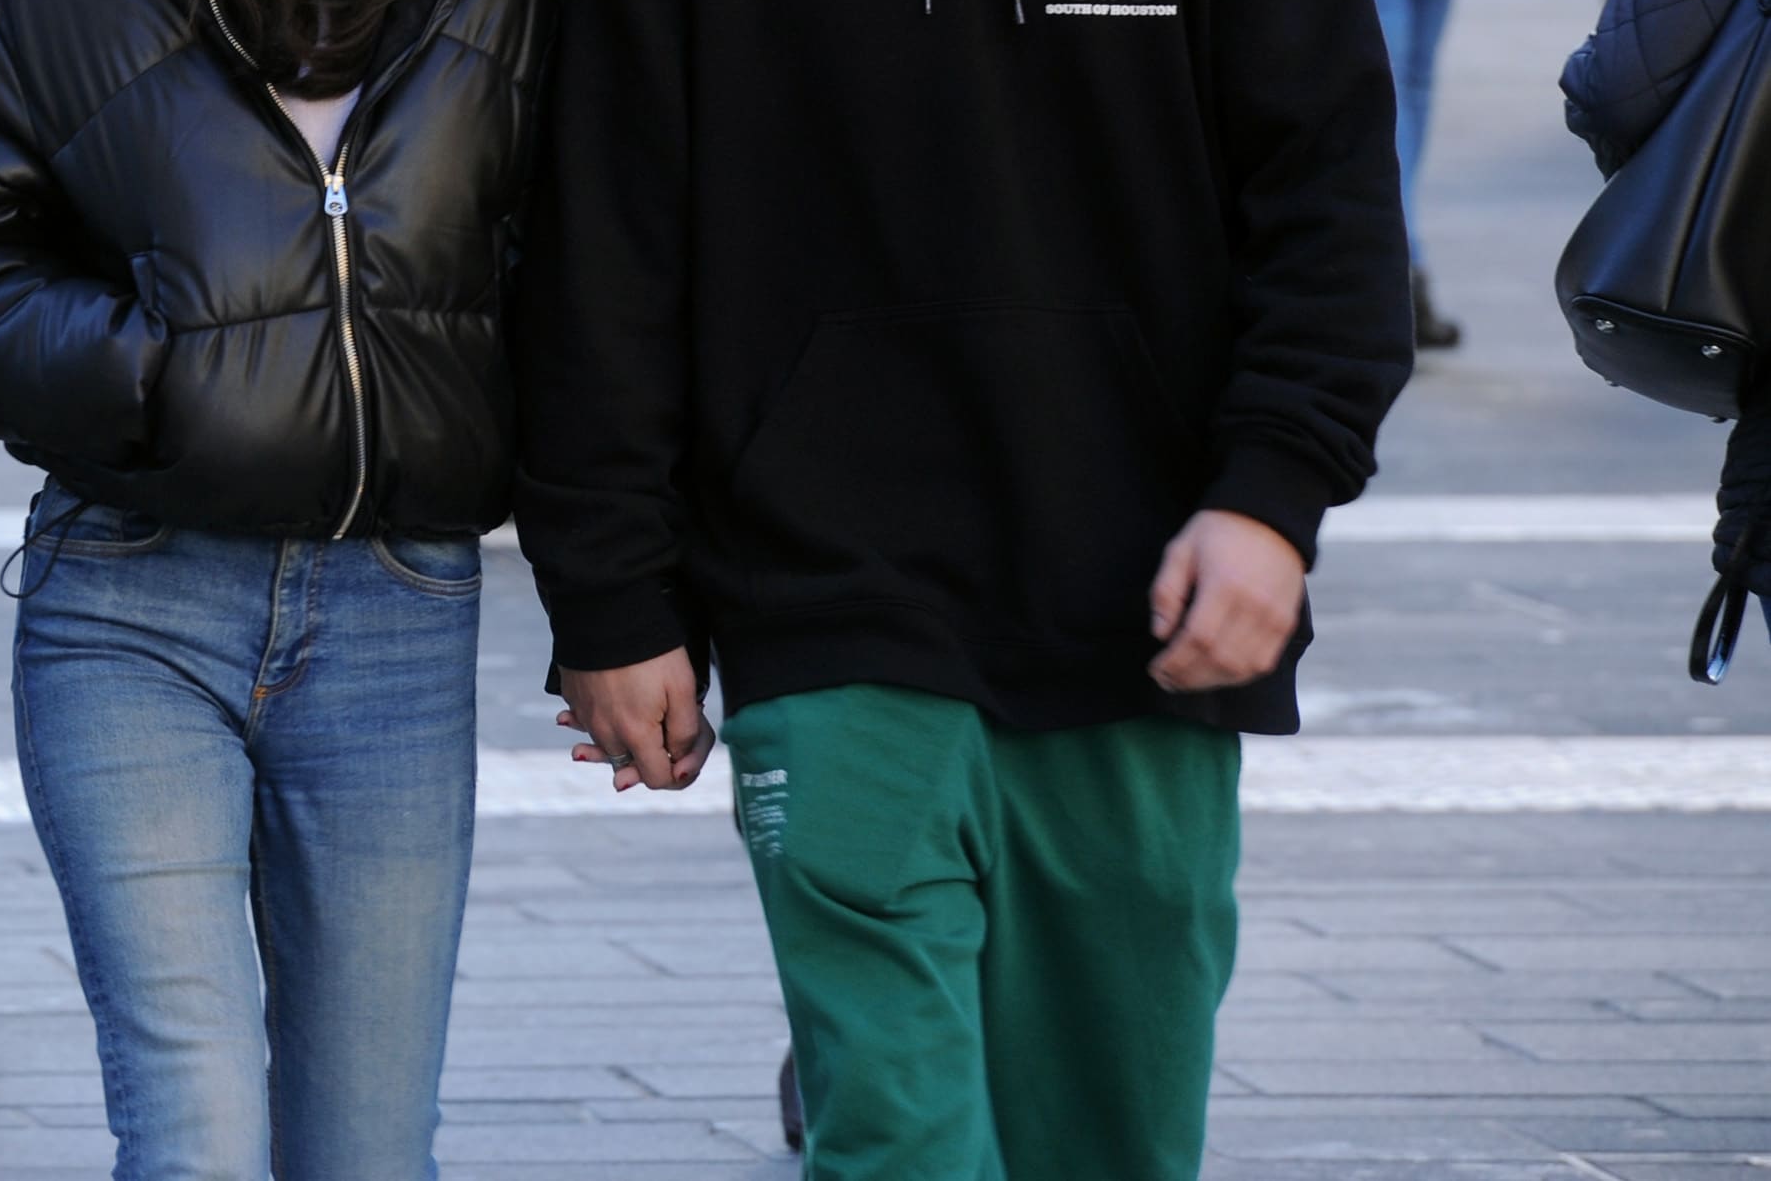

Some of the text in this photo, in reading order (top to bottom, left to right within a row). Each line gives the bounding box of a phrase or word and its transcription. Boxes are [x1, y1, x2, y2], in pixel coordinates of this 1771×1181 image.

[1045, 3, 1177, 16] SOUTH OF HOUSTON
